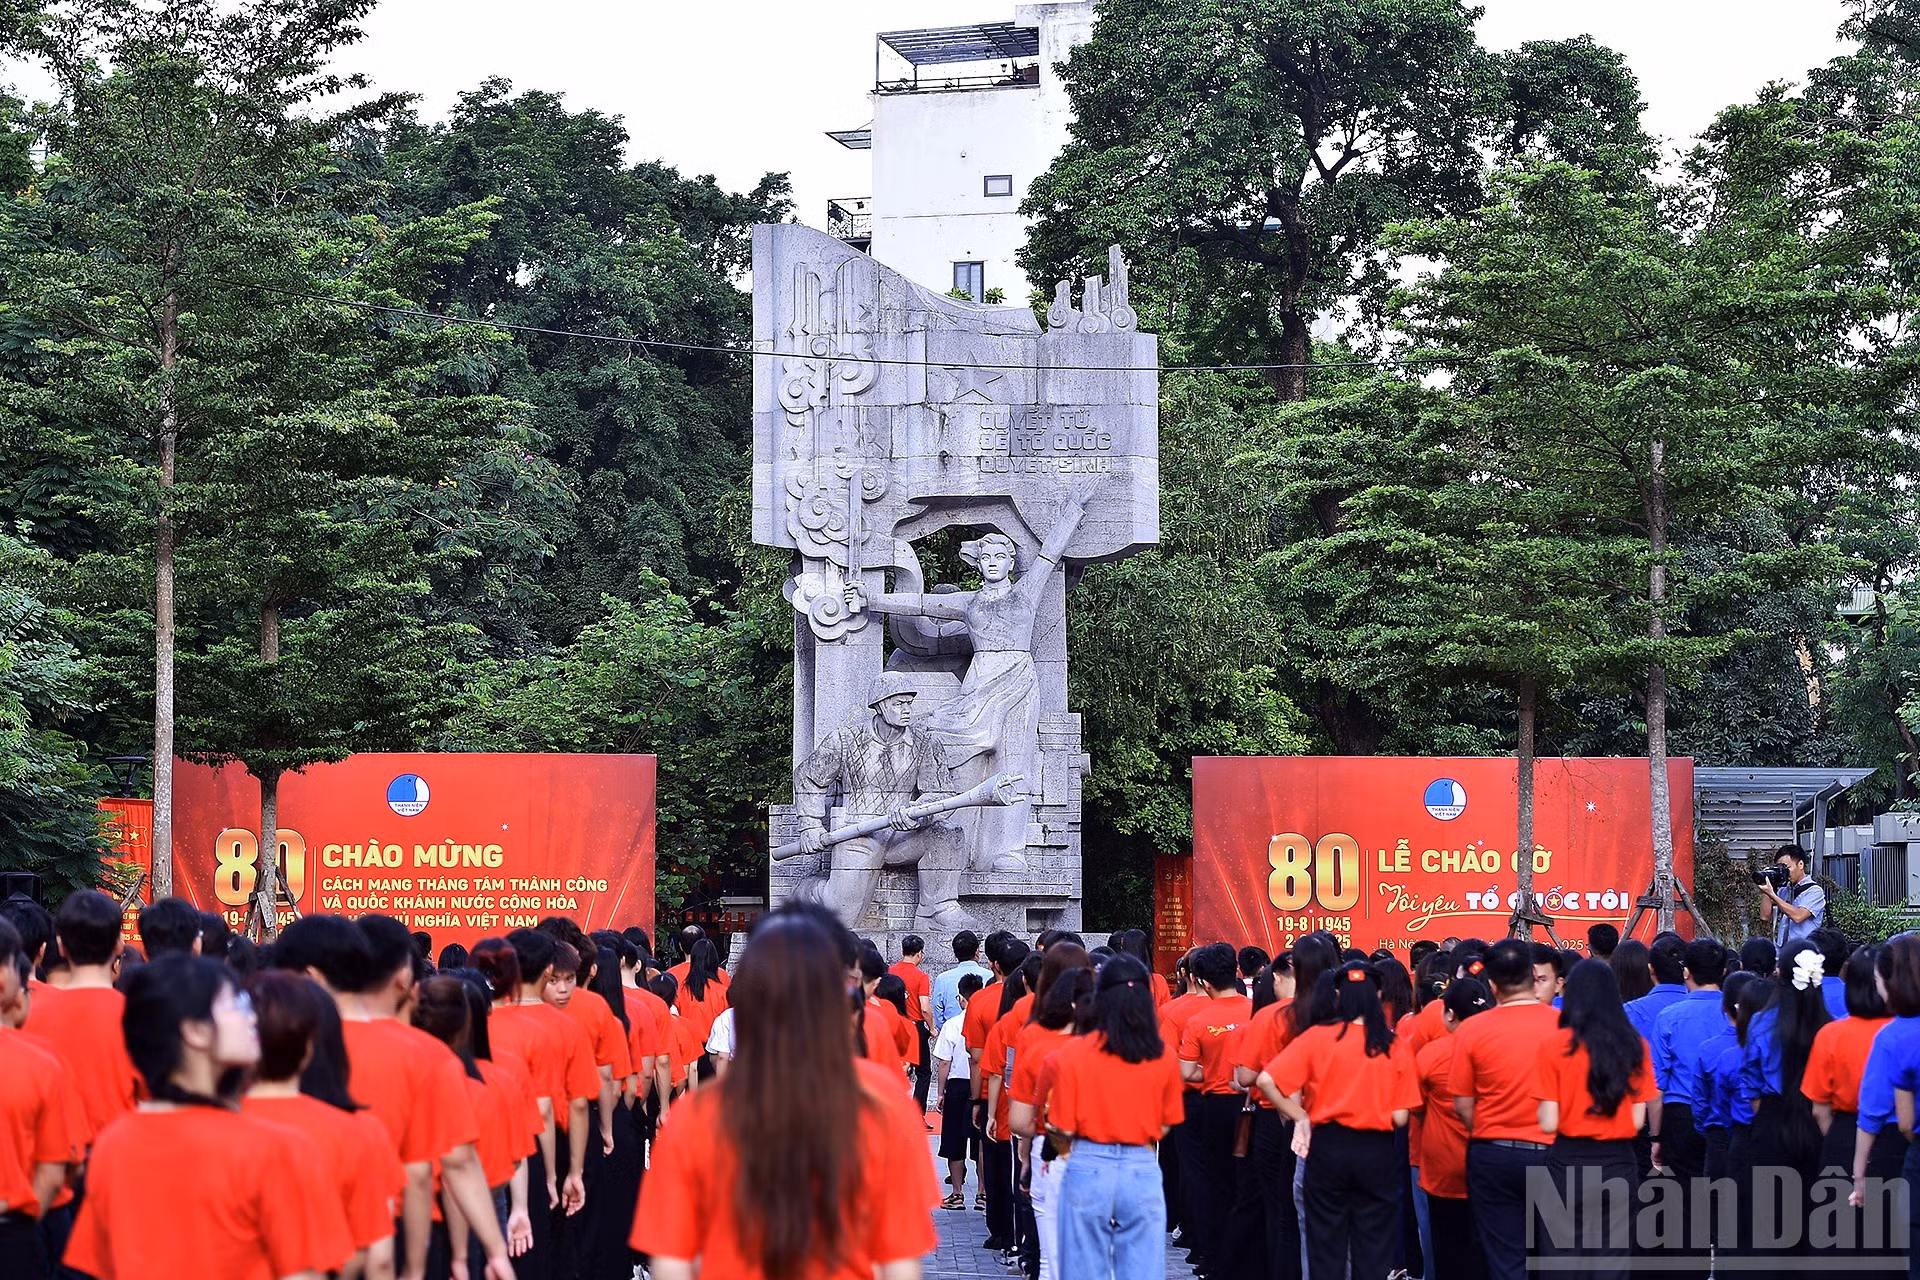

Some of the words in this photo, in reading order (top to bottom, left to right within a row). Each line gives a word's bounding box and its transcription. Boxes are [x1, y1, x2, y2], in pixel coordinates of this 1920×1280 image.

[322, 838, 403, 868] CHÀO
[413, 838, 504, 868] MỪNG
[1378, 838, 1411, 873] LỄ
[1421, 843, 1501, 873] CHÀO
[1268, 832, 1360, 911] 80
[322, 875, 363, 891] CÁCH
[368, 878, 412, 894] MẠNG
[417, 875, 469, 891] THÁNG
[473, 875, 505, 891] TÁM
[509, 875, 561, 891] THÀNH
[565, 876, 608, 892] CÔNG
[322, 893, 343, 909] VÀ
[346, 891, 389, 910] QUỐC
[393, 893, 446, 909] KHÁNH
[450, 893, 495, 909] NƯỚC
[499, 893, 541, 913] CỘNG
[546, 893, 578, 910] HÒA
[1412, 895, 1460, 929] yêu
[1465, 885, 1500, 910] TỔ
[1585, 888, 1629, 910] TÔI
[414, 911, 461, 928] NGHĨA
[466, 911, 500, 931] VIỆT
[504, 915, 538, 928] NAM
[1317, 916, 1351, 931] 1945
[1379, 938, 1394, 949] Hà
[1555, 939, 1584, 950] 025
